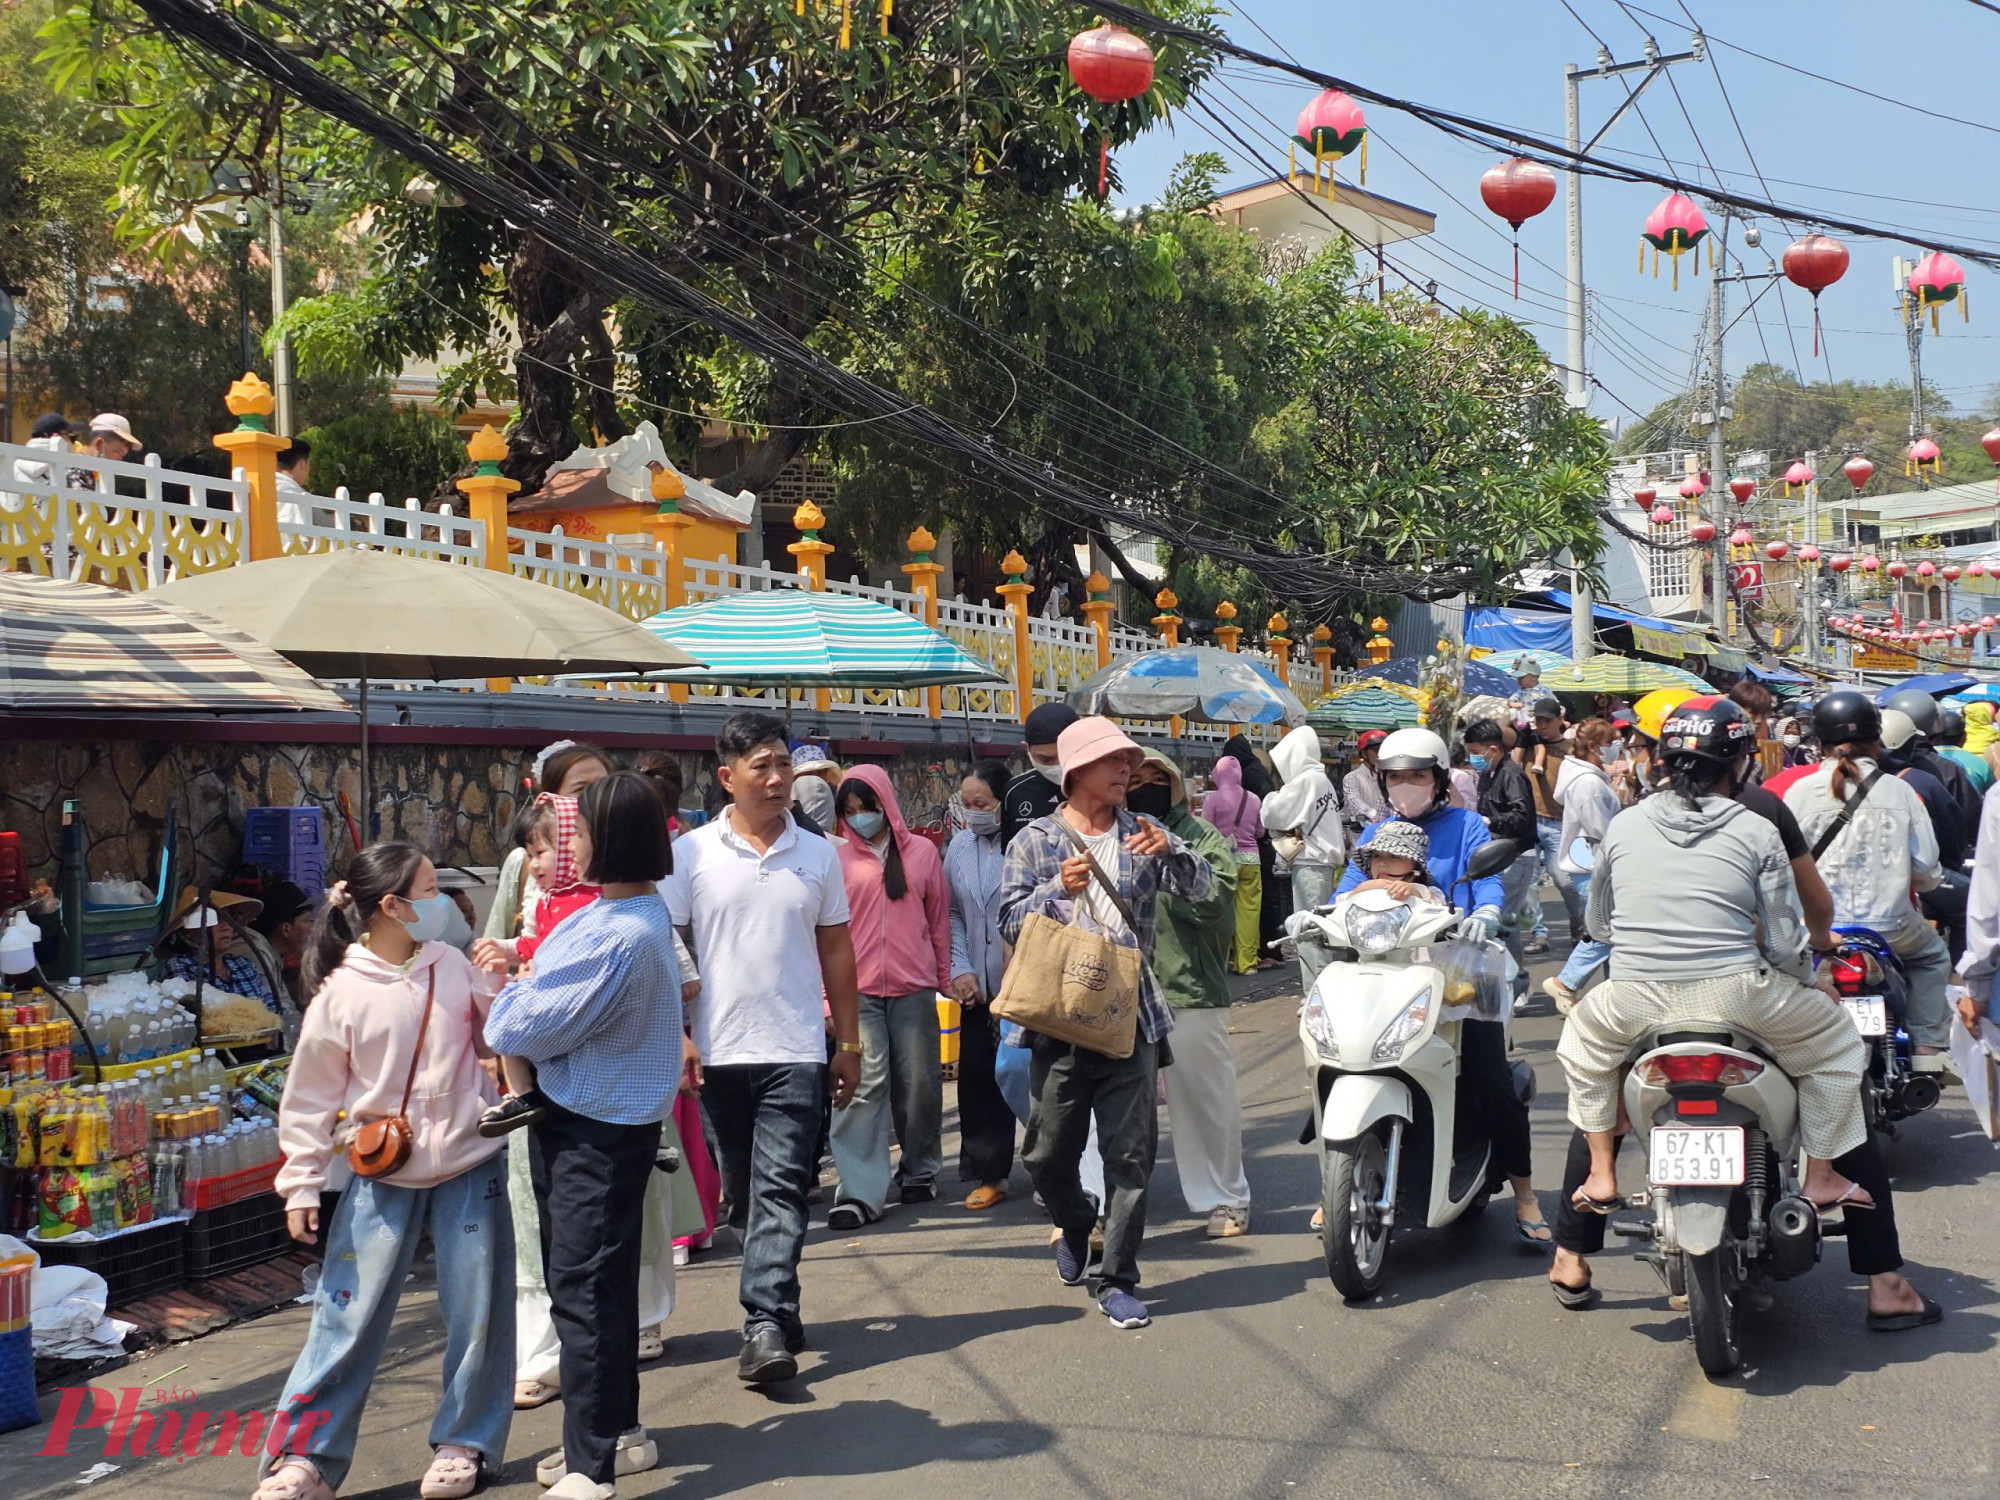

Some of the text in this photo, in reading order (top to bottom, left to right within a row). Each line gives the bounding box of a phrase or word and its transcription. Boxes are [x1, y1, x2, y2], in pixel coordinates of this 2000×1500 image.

[1840, 999, 1872, 1014] -E1
[1666, 1132, 1725, 1154] 67-K1
[1658, 1157, 1734, 1180] 853.91
